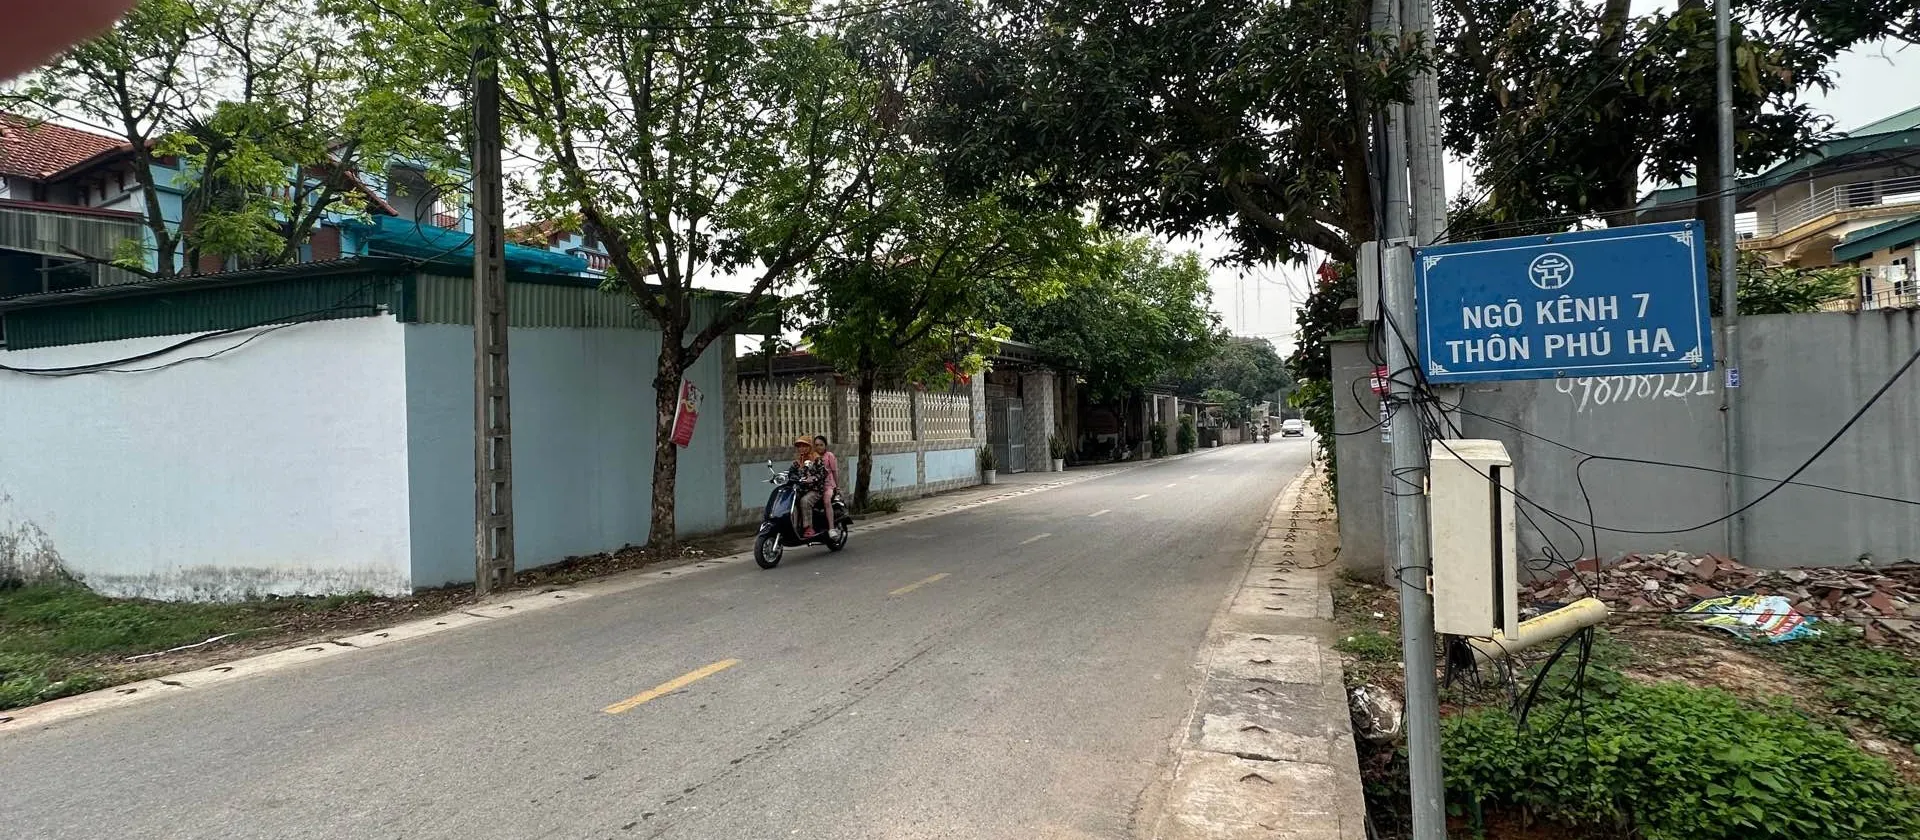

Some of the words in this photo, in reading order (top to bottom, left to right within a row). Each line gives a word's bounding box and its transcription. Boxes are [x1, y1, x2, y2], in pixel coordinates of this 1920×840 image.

[1463, 298, 1523, 330] NGÕ
[1536, 294, 1618, 325] KÊNH
[1632, 293, 1650, 318] 7
[1446, 333, 1530, 364] THÔN
[1544, 326, 1612, 359] PHÚ
[1627, 327, 1676, 358] HẠ
